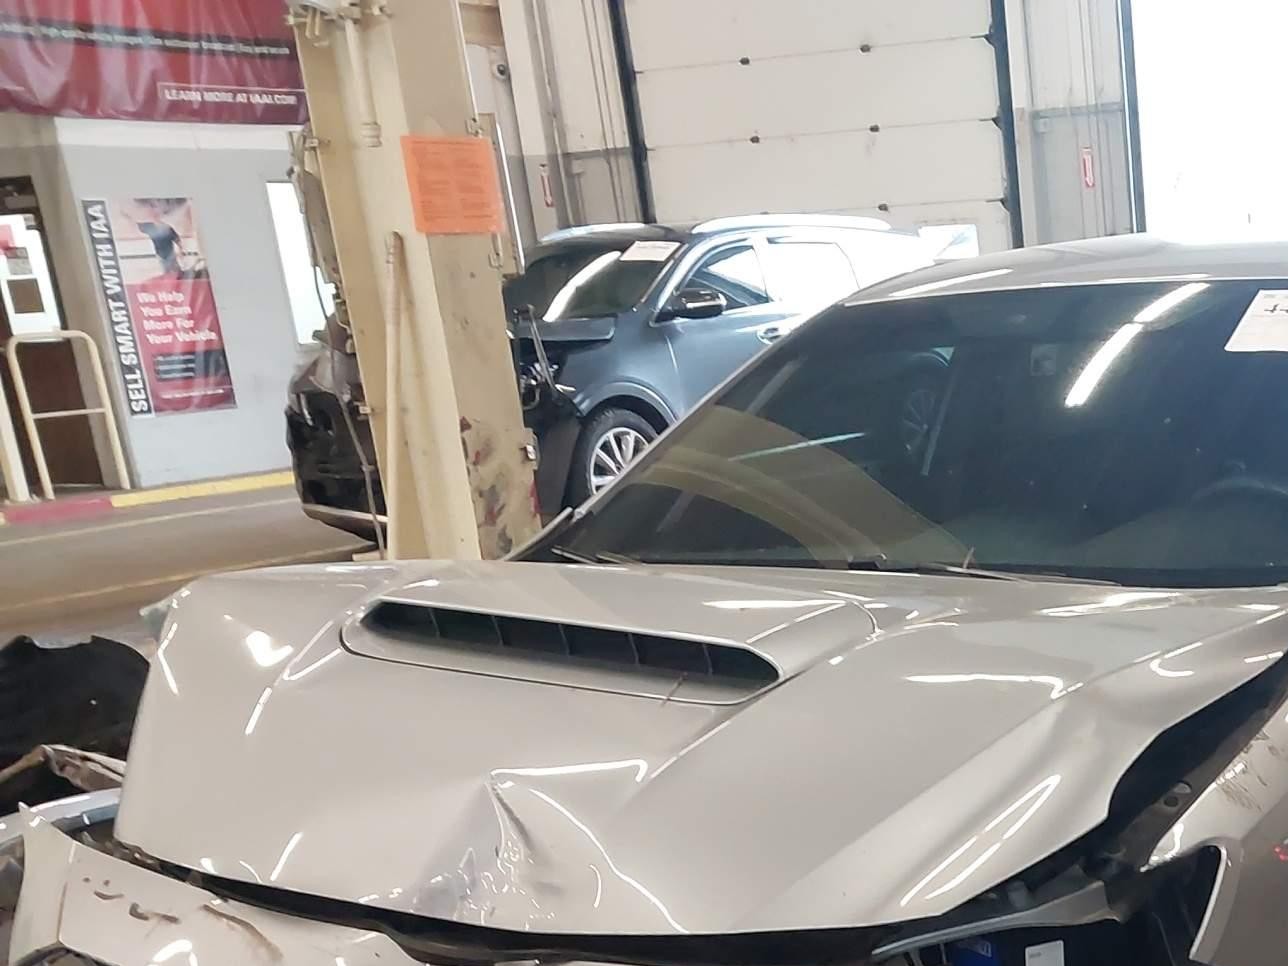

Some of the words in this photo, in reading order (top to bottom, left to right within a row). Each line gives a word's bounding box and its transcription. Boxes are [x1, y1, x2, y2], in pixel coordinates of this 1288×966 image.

[164, 89, 202, 101] LEARN
[203, 91, 234, 102] MORE
[236, 93, 248, 103] AT
[87, 204, 110, 239] IAA
[95, 243, 122, 295] WITH
[136, 292, 156, 303] We
[157, 291, 185, 303] Help
[140, 306, 163, 317] You
[164, 304, 192, 316] Earn
[108, 298, 139, 366] SMART
[143, 319, 174, 331] More
[175, 317, 195, 329] For
[146, 334, 174, 345] Your
[174, 329, 219, 342] Vehicle
[124, 368, 149, 412] SELL
